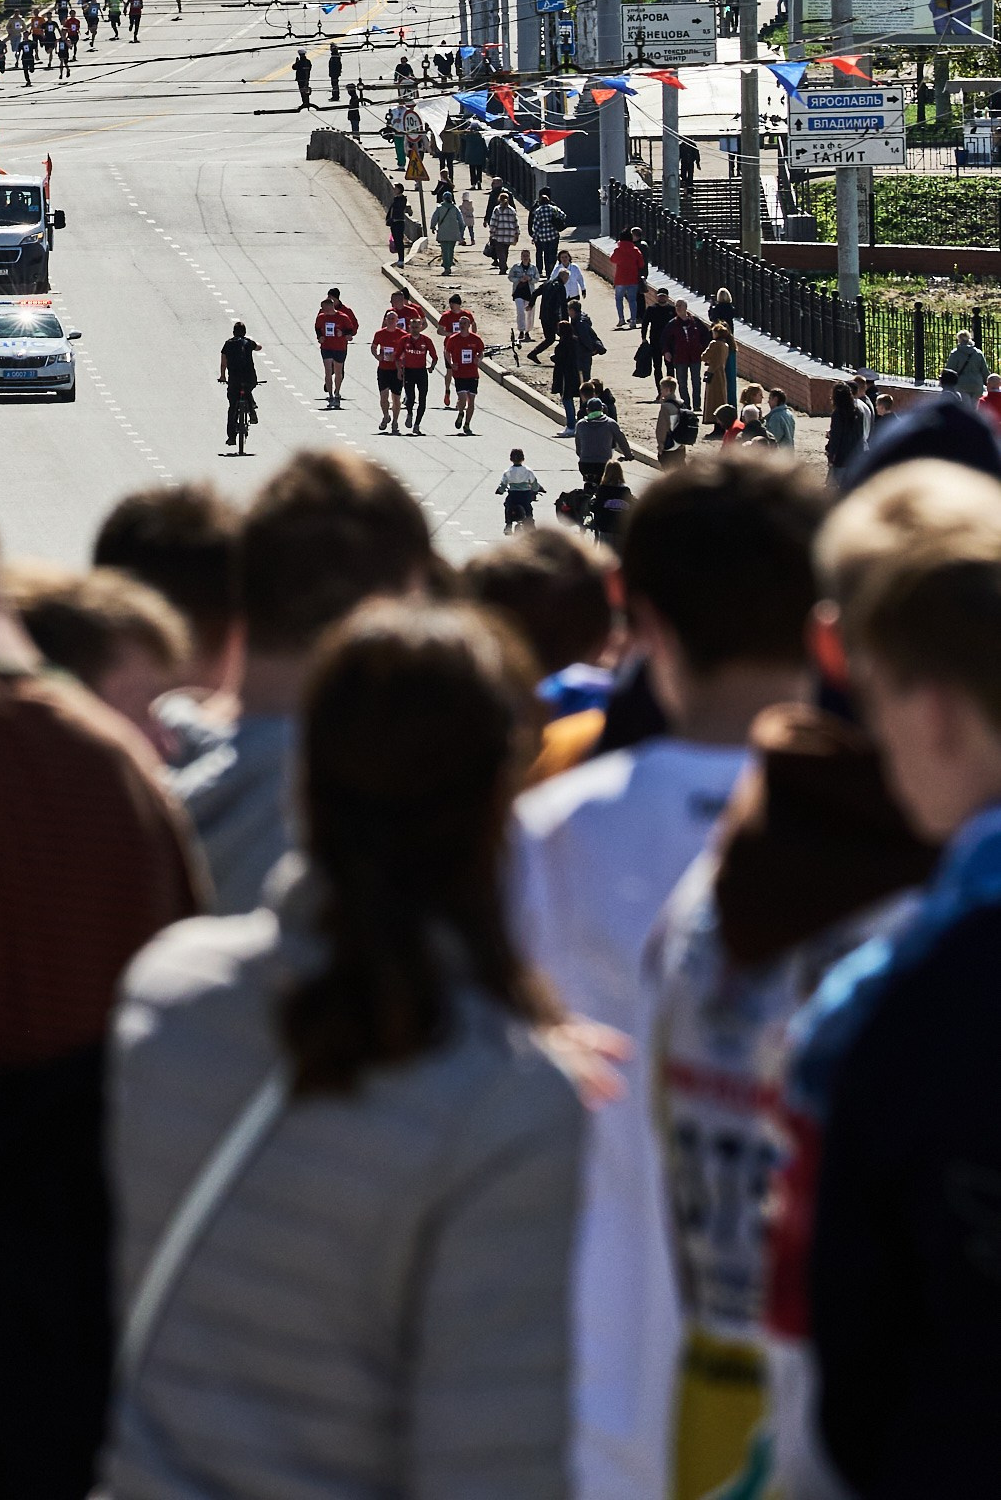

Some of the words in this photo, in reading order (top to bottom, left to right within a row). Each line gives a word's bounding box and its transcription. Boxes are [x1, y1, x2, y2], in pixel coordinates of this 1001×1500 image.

[627, 13, 669, 22] ЖАРОВА
[628, 30, 690, 39] КУЗНЕЦОВА
[811, 96, 882, 107] ЯРОСЛАВЛЬ
[813, 118, 878, 129] ВЛАДИМИР
[813, 151, 866, 163] ТАНИТ
